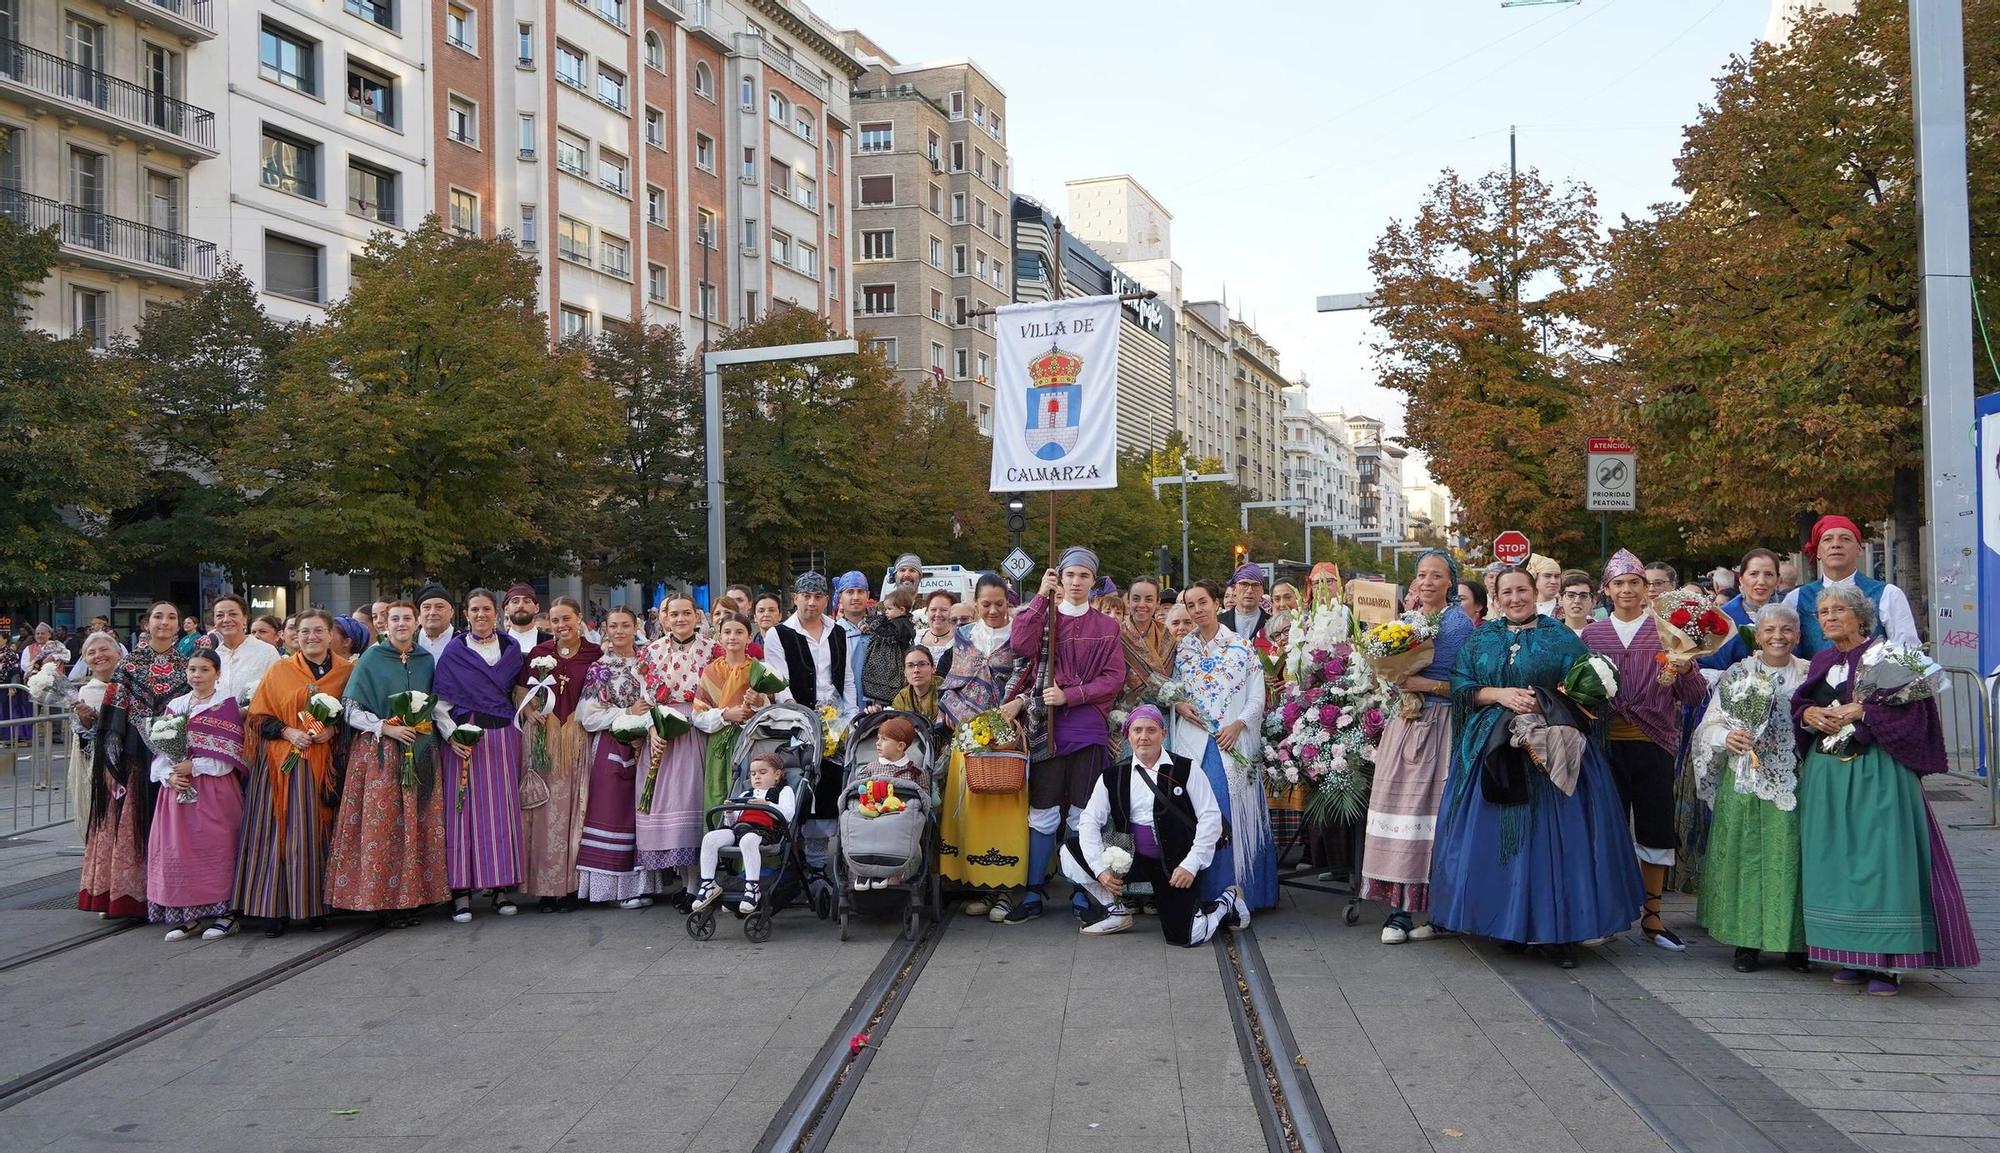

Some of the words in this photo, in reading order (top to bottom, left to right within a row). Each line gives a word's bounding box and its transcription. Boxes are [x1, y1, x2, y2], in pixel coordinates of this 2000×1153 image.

[1021, 321, 1067, 339] VILLA
[1073, 318, 1094, 334] DE
[1007, 465, 1100, 482] CALMARZA
[1600, 466, 1624, 481] 20
[1498, 543, 1526, 553] STOP
[1010, 558, 1026, 570] 30
[251, 598, 273, 608] Aural
